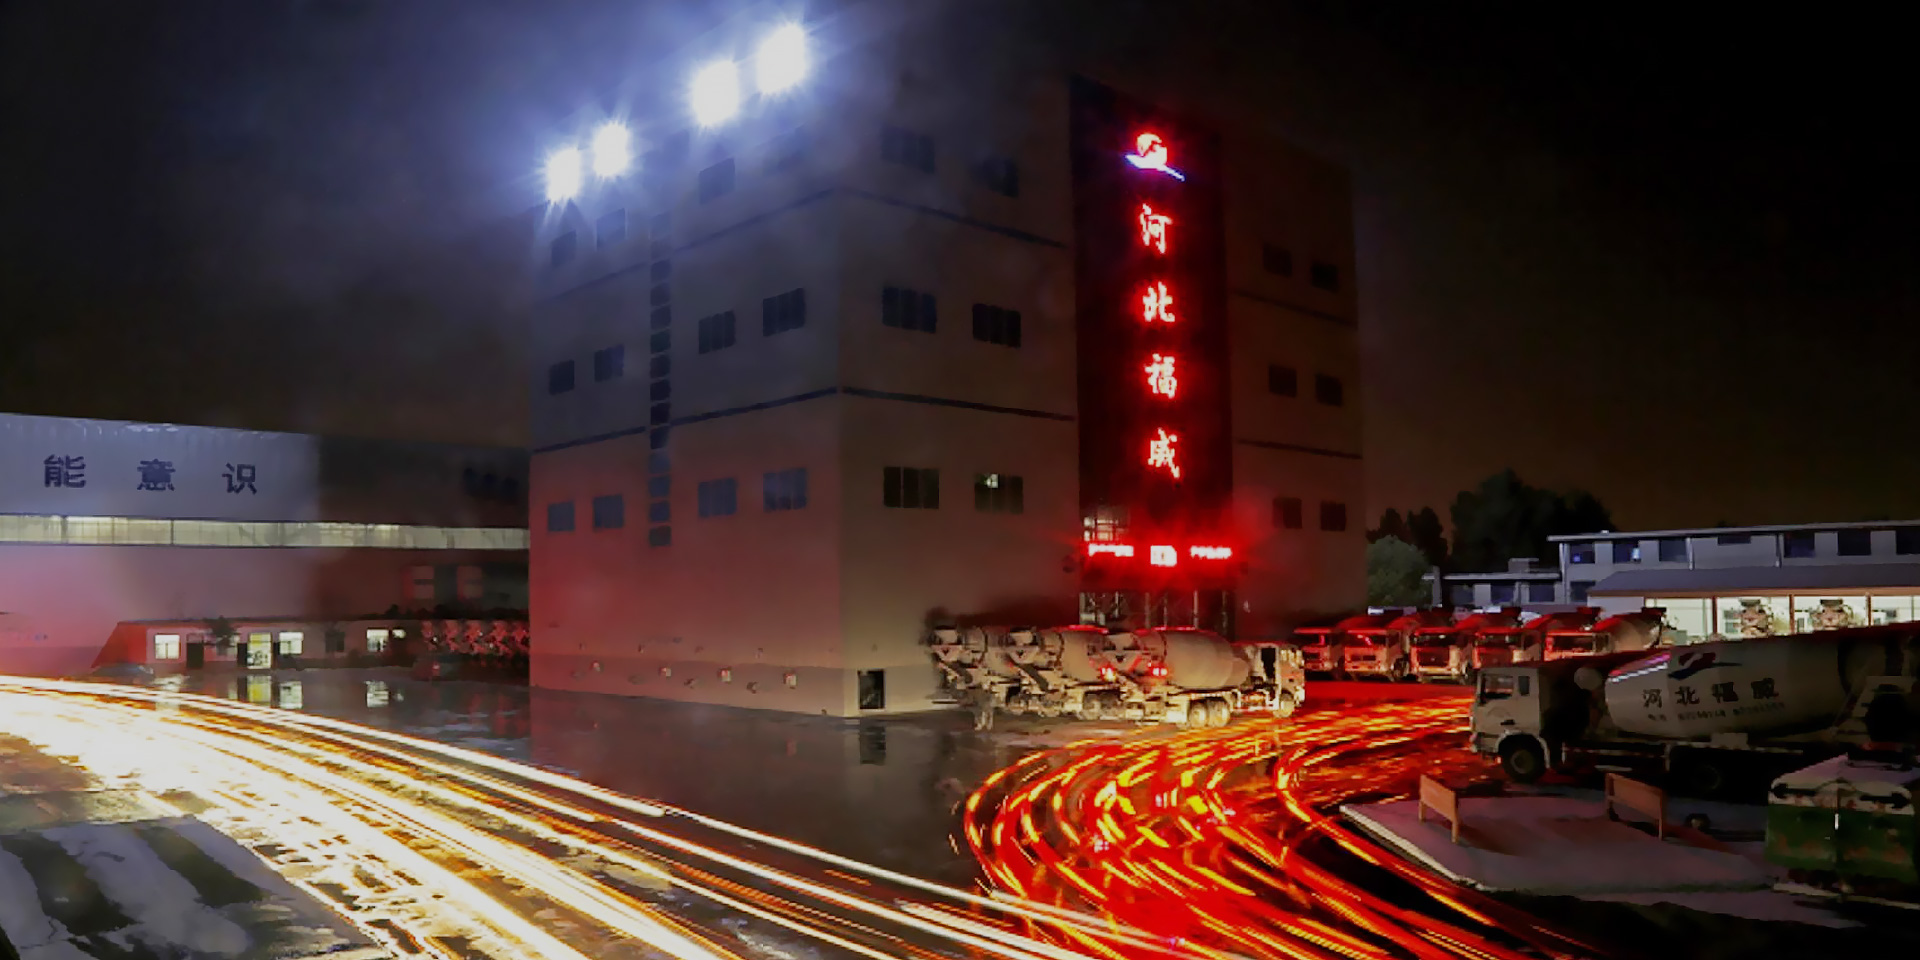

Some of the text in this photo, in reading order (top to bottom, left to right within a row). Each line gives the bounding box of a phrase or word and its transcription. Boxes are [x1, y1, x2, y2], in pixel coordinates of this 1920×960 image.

[1139, 204, 1180, 479] 河北福威
[43, 455, 257, 494] 能意识
